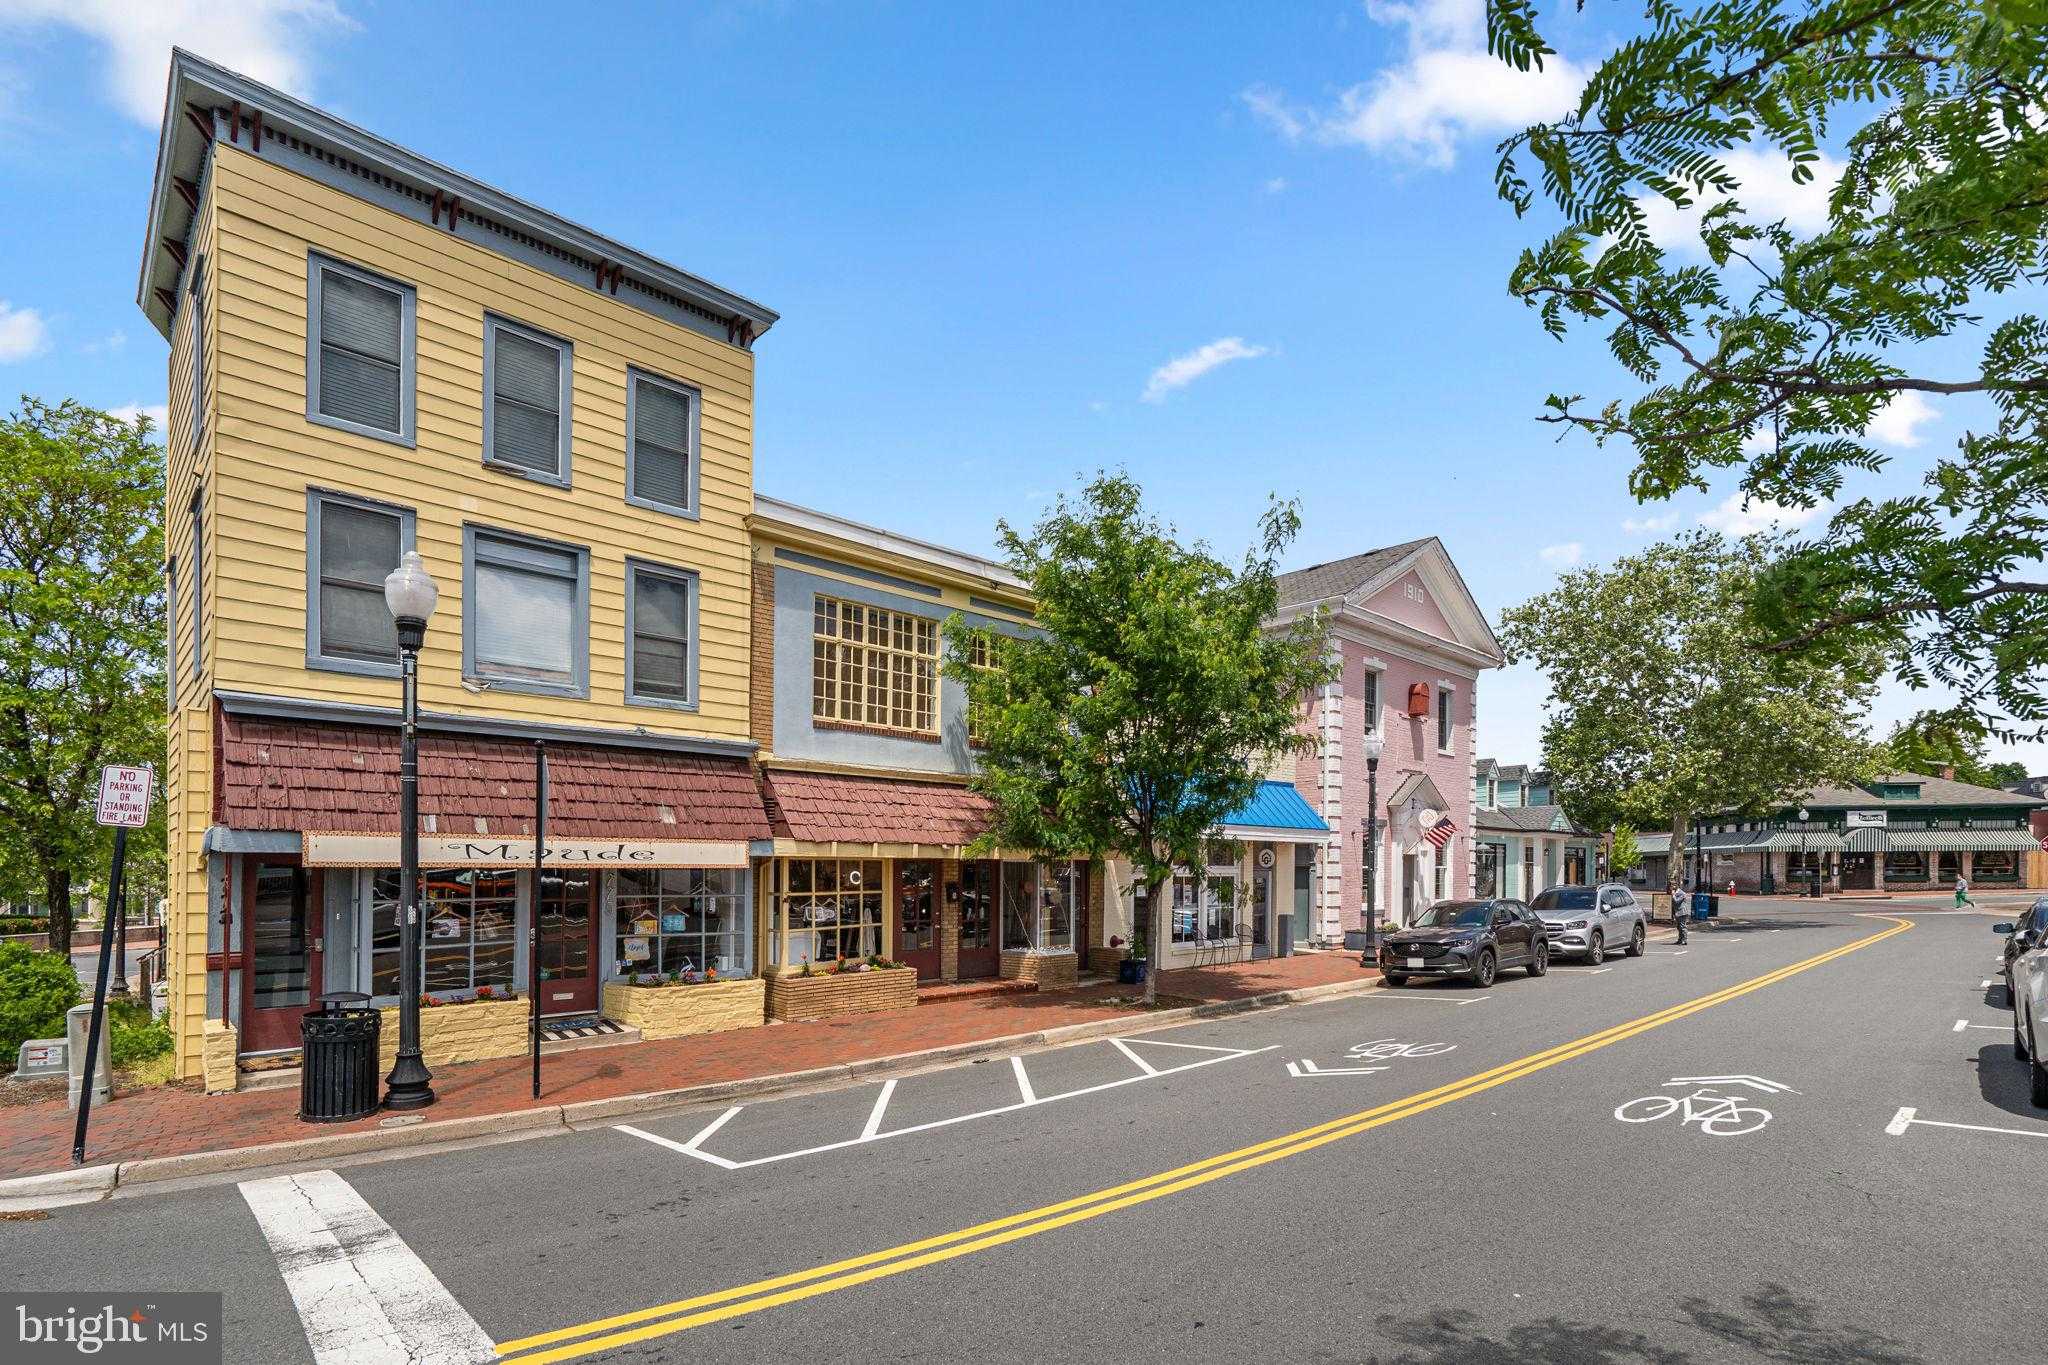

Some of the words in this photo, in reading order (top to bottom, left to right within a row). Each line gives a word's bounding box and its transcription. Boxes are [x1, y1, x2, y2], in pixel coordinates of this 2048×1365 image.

[1403, 581, 1424, 603] 1910
[119, 771, 136, 782] NO
[109, 781, 143, 793] PARKING
[119, 792, 131, 801] OR
[104, 801, 143, 812] STANDING
[101, 811, 119, 821] FIRE
[122, 813, 143, 823] LANE
[447, 843, 656, 861] Maude
